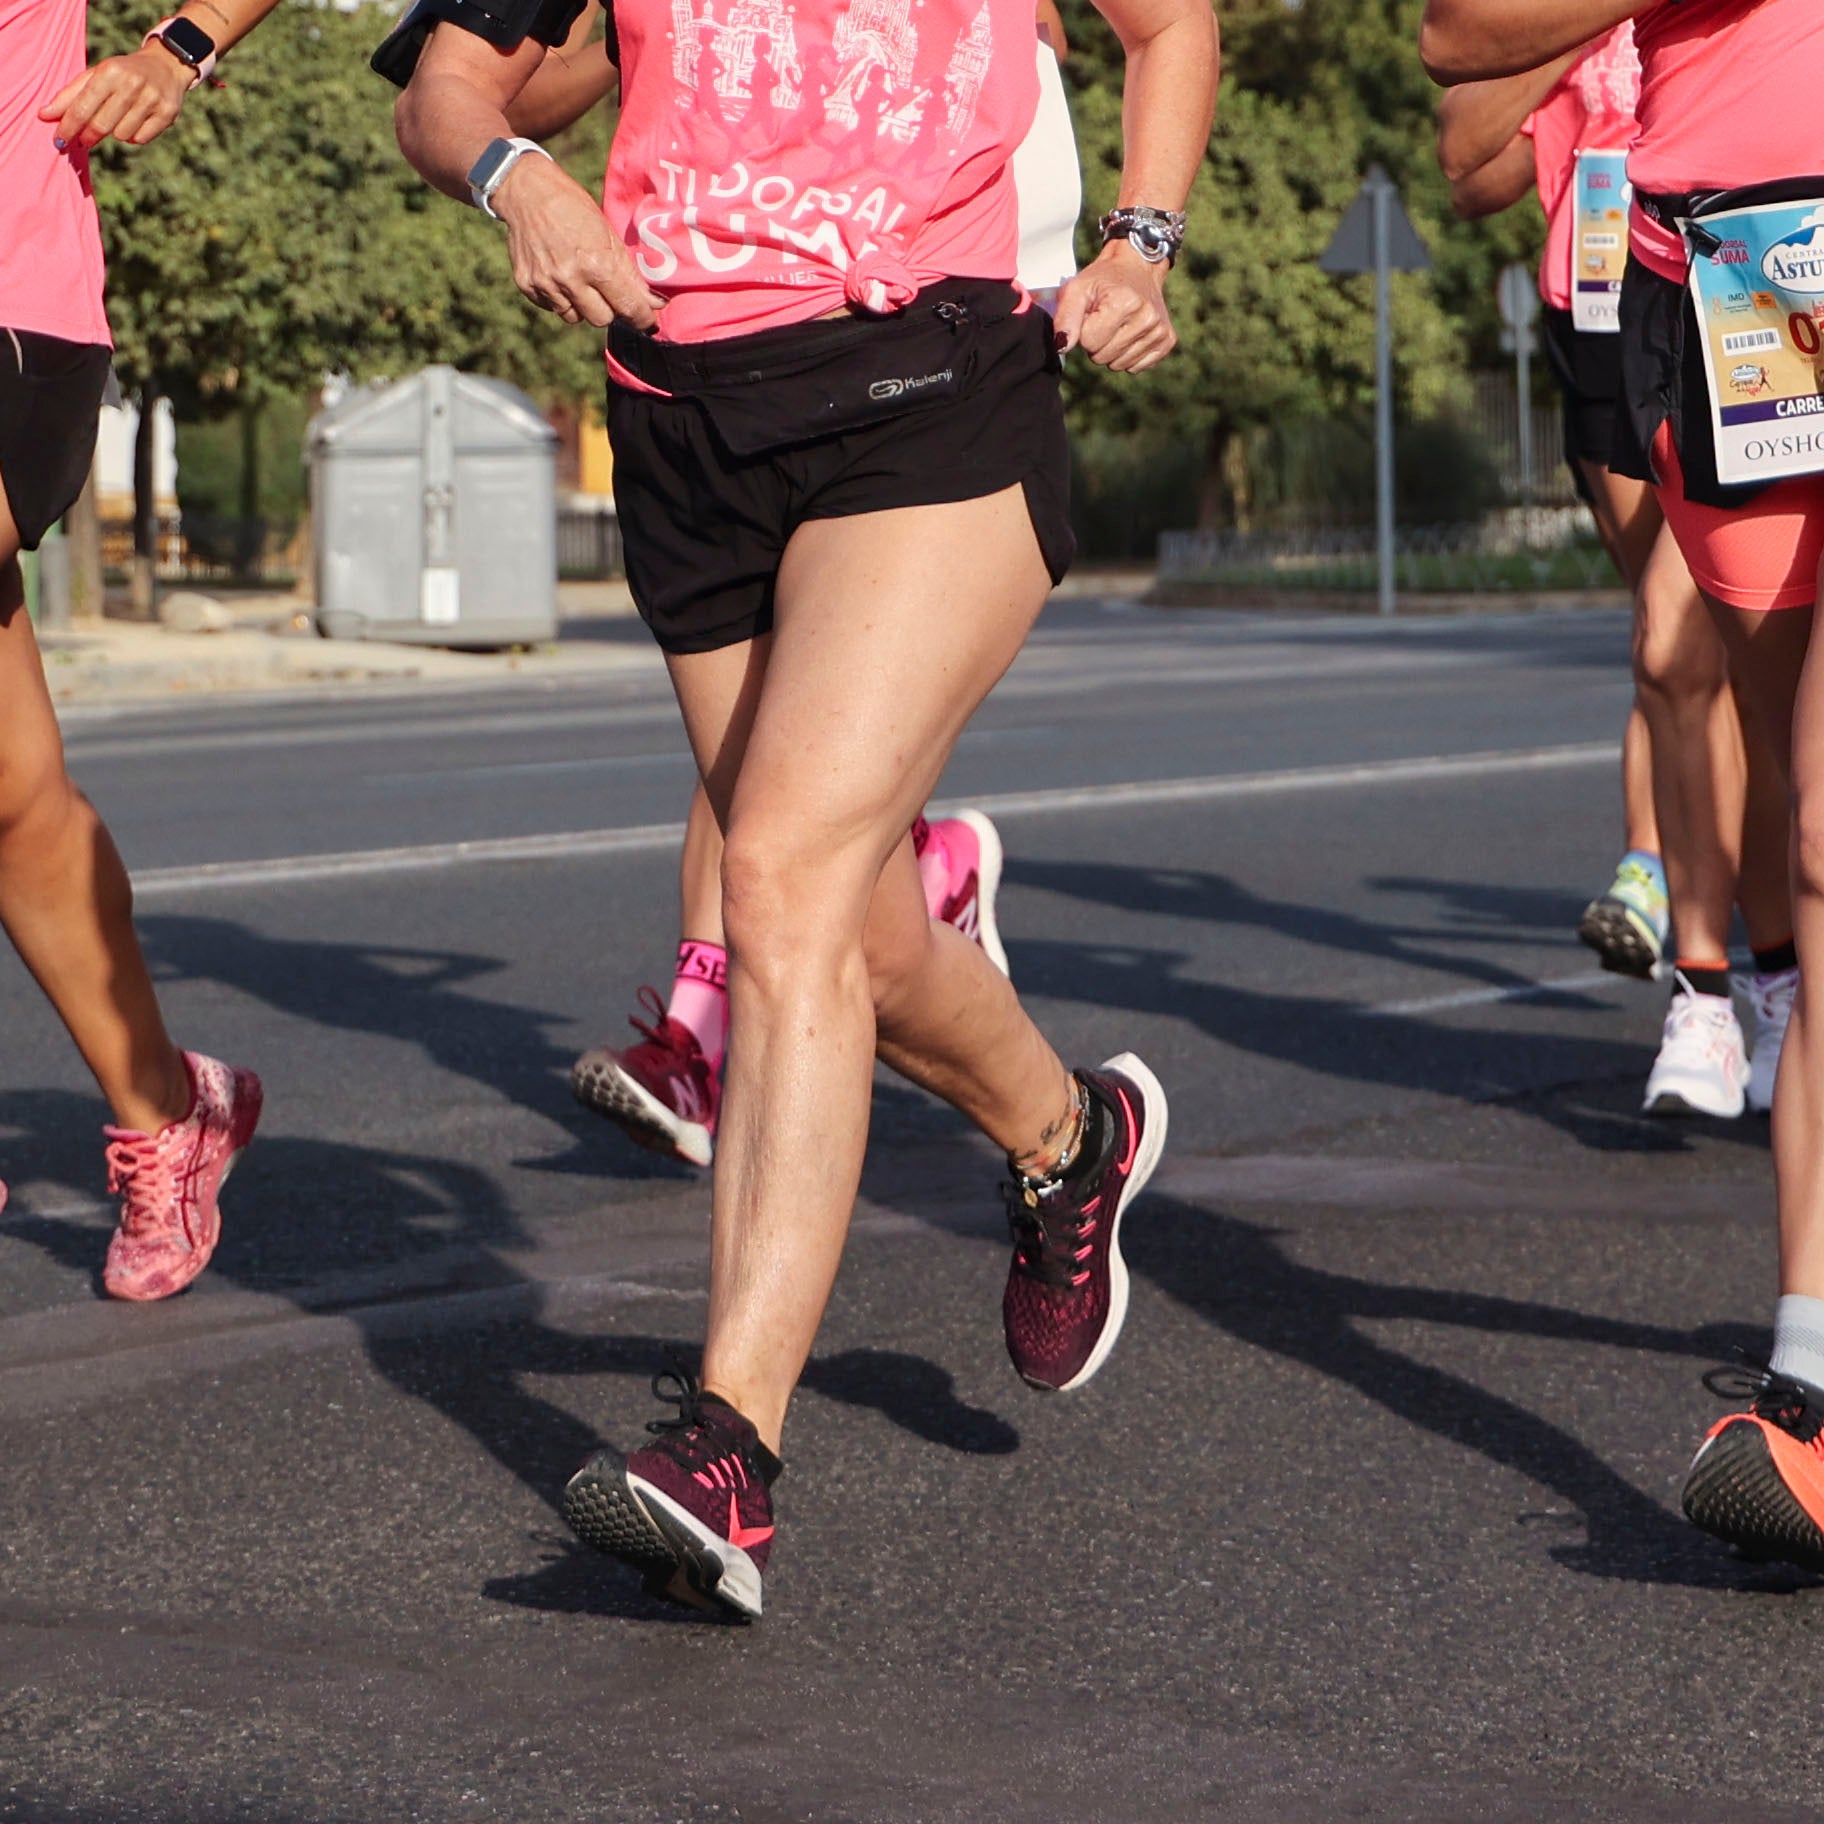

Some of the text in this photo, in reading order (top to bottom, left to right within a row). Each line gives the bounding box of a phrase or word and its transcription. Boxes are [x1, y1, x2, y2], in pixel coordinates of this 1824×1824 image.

[636, 206, 879, 281] SUM
[1711, 249, 1750, 267] SUMA
[904, 369, 953, 390] Kalenji
